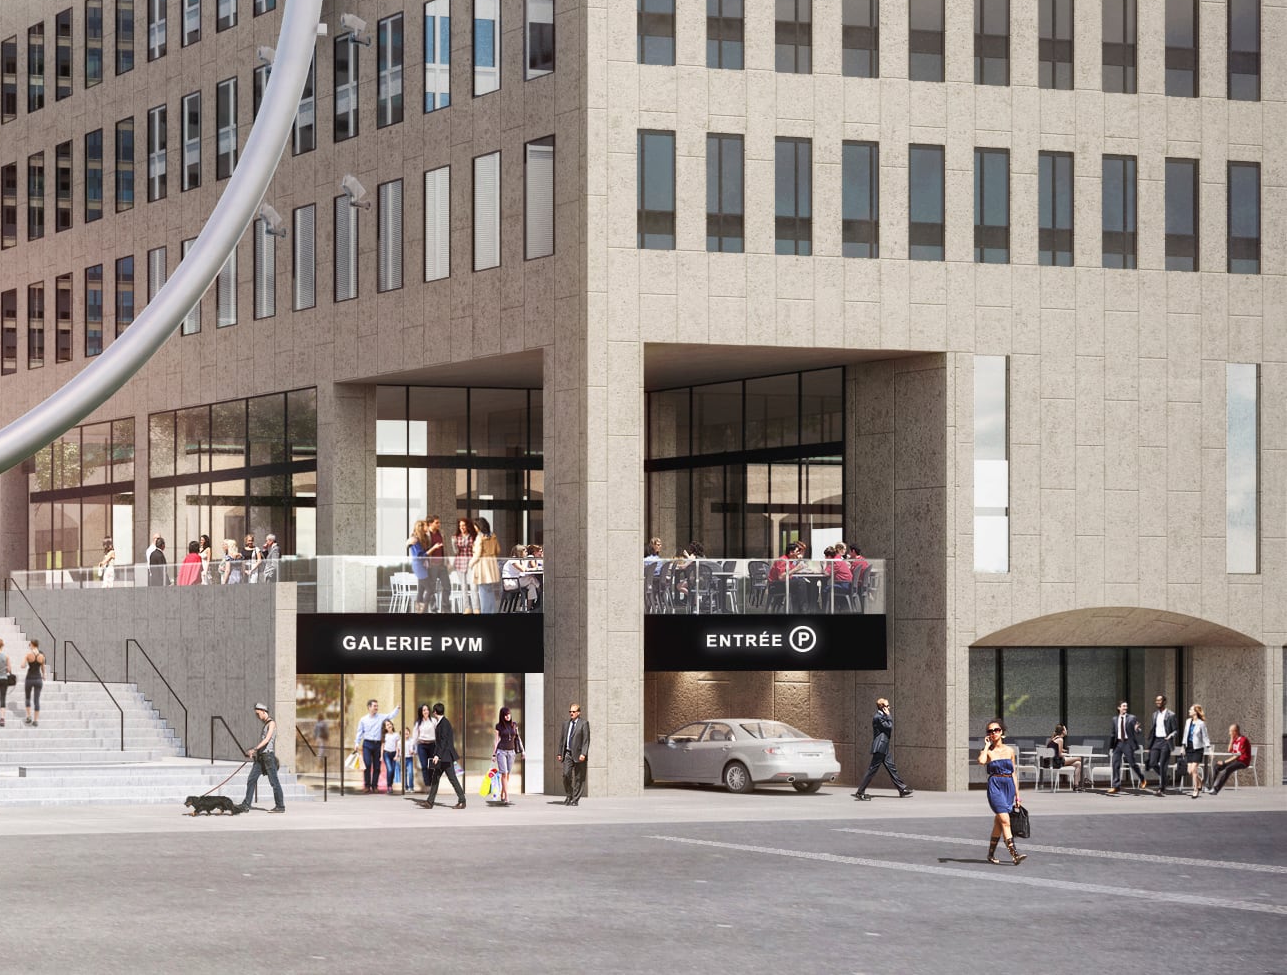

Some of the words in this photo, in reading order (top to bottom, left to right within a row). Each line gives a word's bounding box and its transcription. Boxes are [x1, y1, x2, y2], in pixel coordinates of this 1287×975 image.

[342, 635, 433, 651] GALERIE
[441, 636, 483, 652] PVM
[706, 630, 783, 648] ENTRÉE
